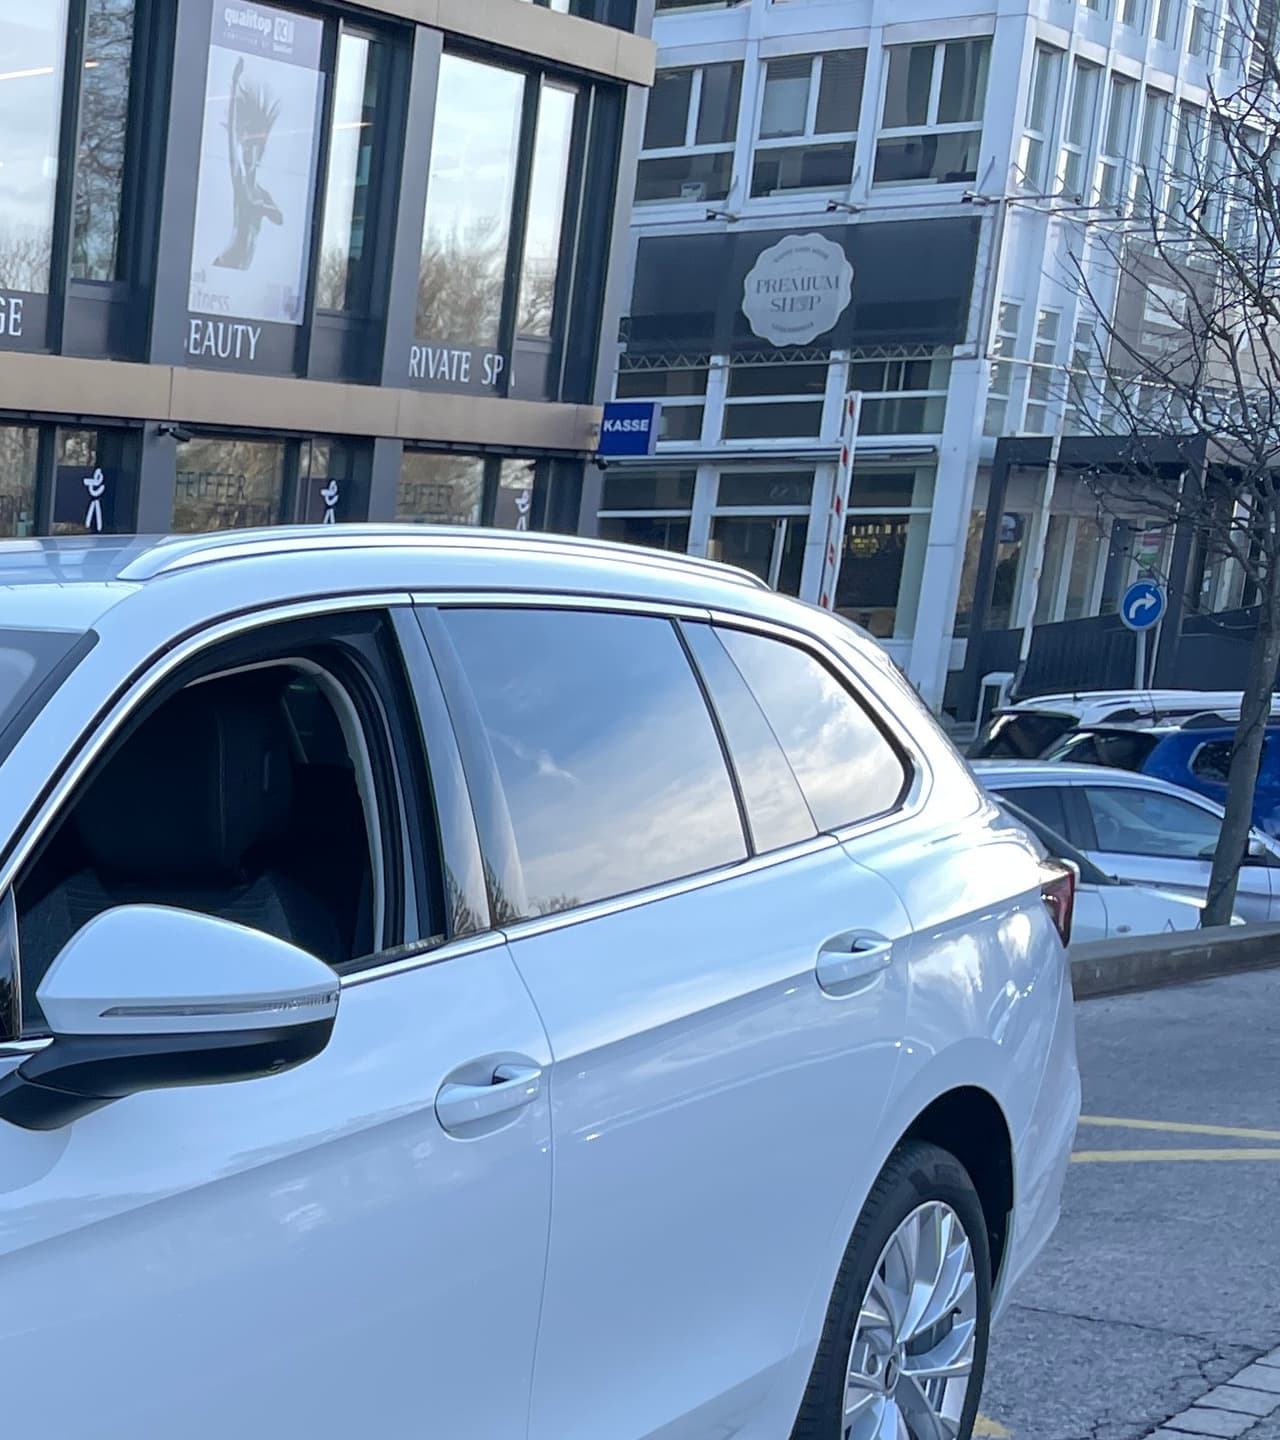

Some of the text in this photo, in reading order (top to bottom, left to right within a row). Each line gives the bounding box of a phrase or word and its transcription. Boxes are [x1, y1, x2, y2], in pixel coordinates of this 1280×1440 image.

[224, 7, 272, 36] qualitop
[756, 274, 840, 294] PREMIUM
[184, 319, 261, 361] EAUTY
[408, 346, 515, 387] RIVATE SP
[603, 418, 650, 432] KASSE
[175, 470, 247, 499] FEIFFER
